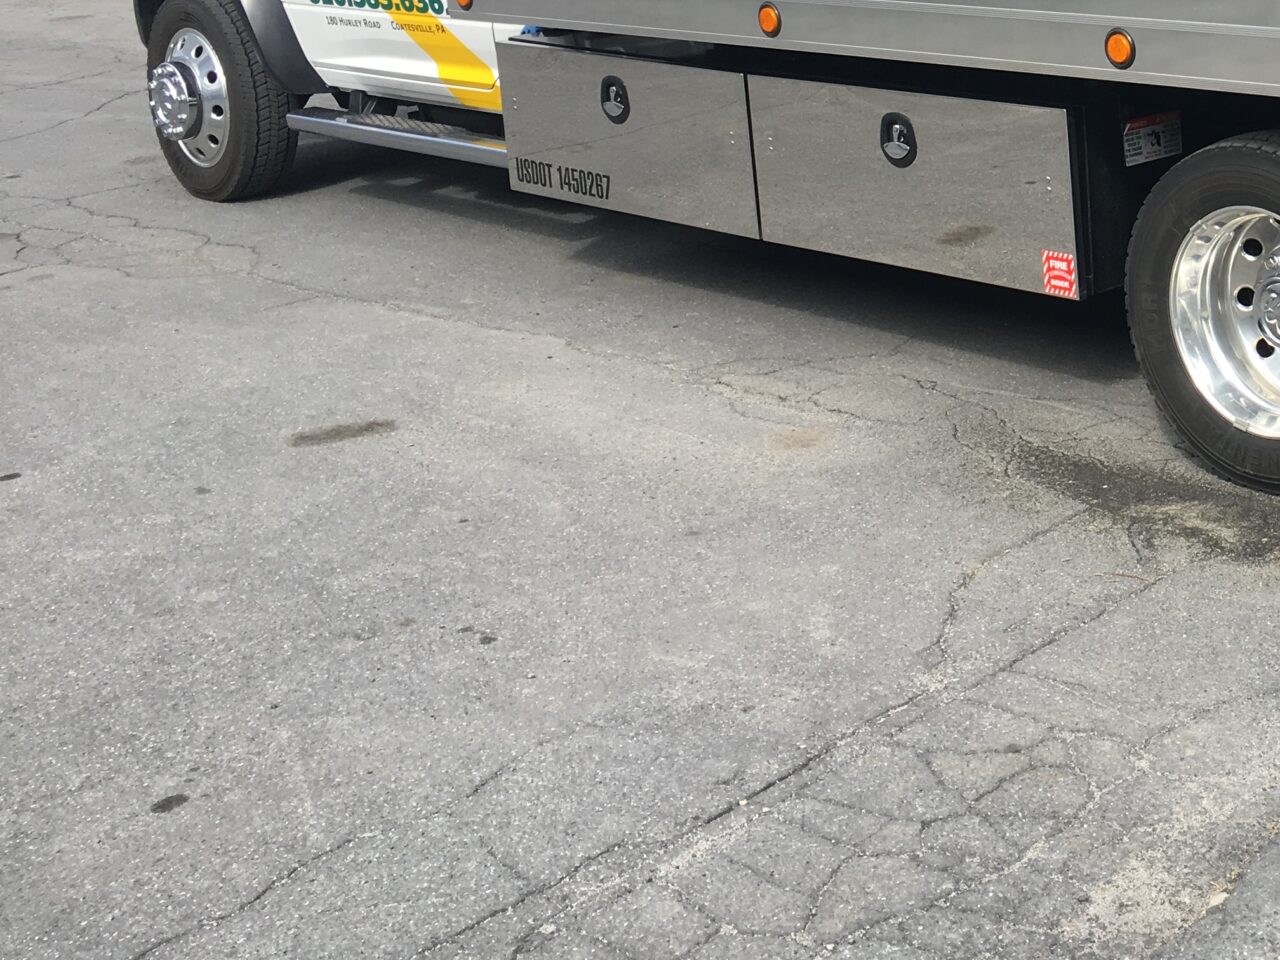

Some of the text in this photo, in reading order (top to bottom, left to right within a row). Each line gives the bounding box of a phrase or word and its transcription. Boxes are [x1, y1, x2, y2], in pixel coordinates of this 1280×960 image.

[326, 16, 338, 25] 180
[437, 24, 446, 34] PA
[515, 156, 610, 200] USDOT 1450267
[1050, 260, 1068, 271] FIRE
